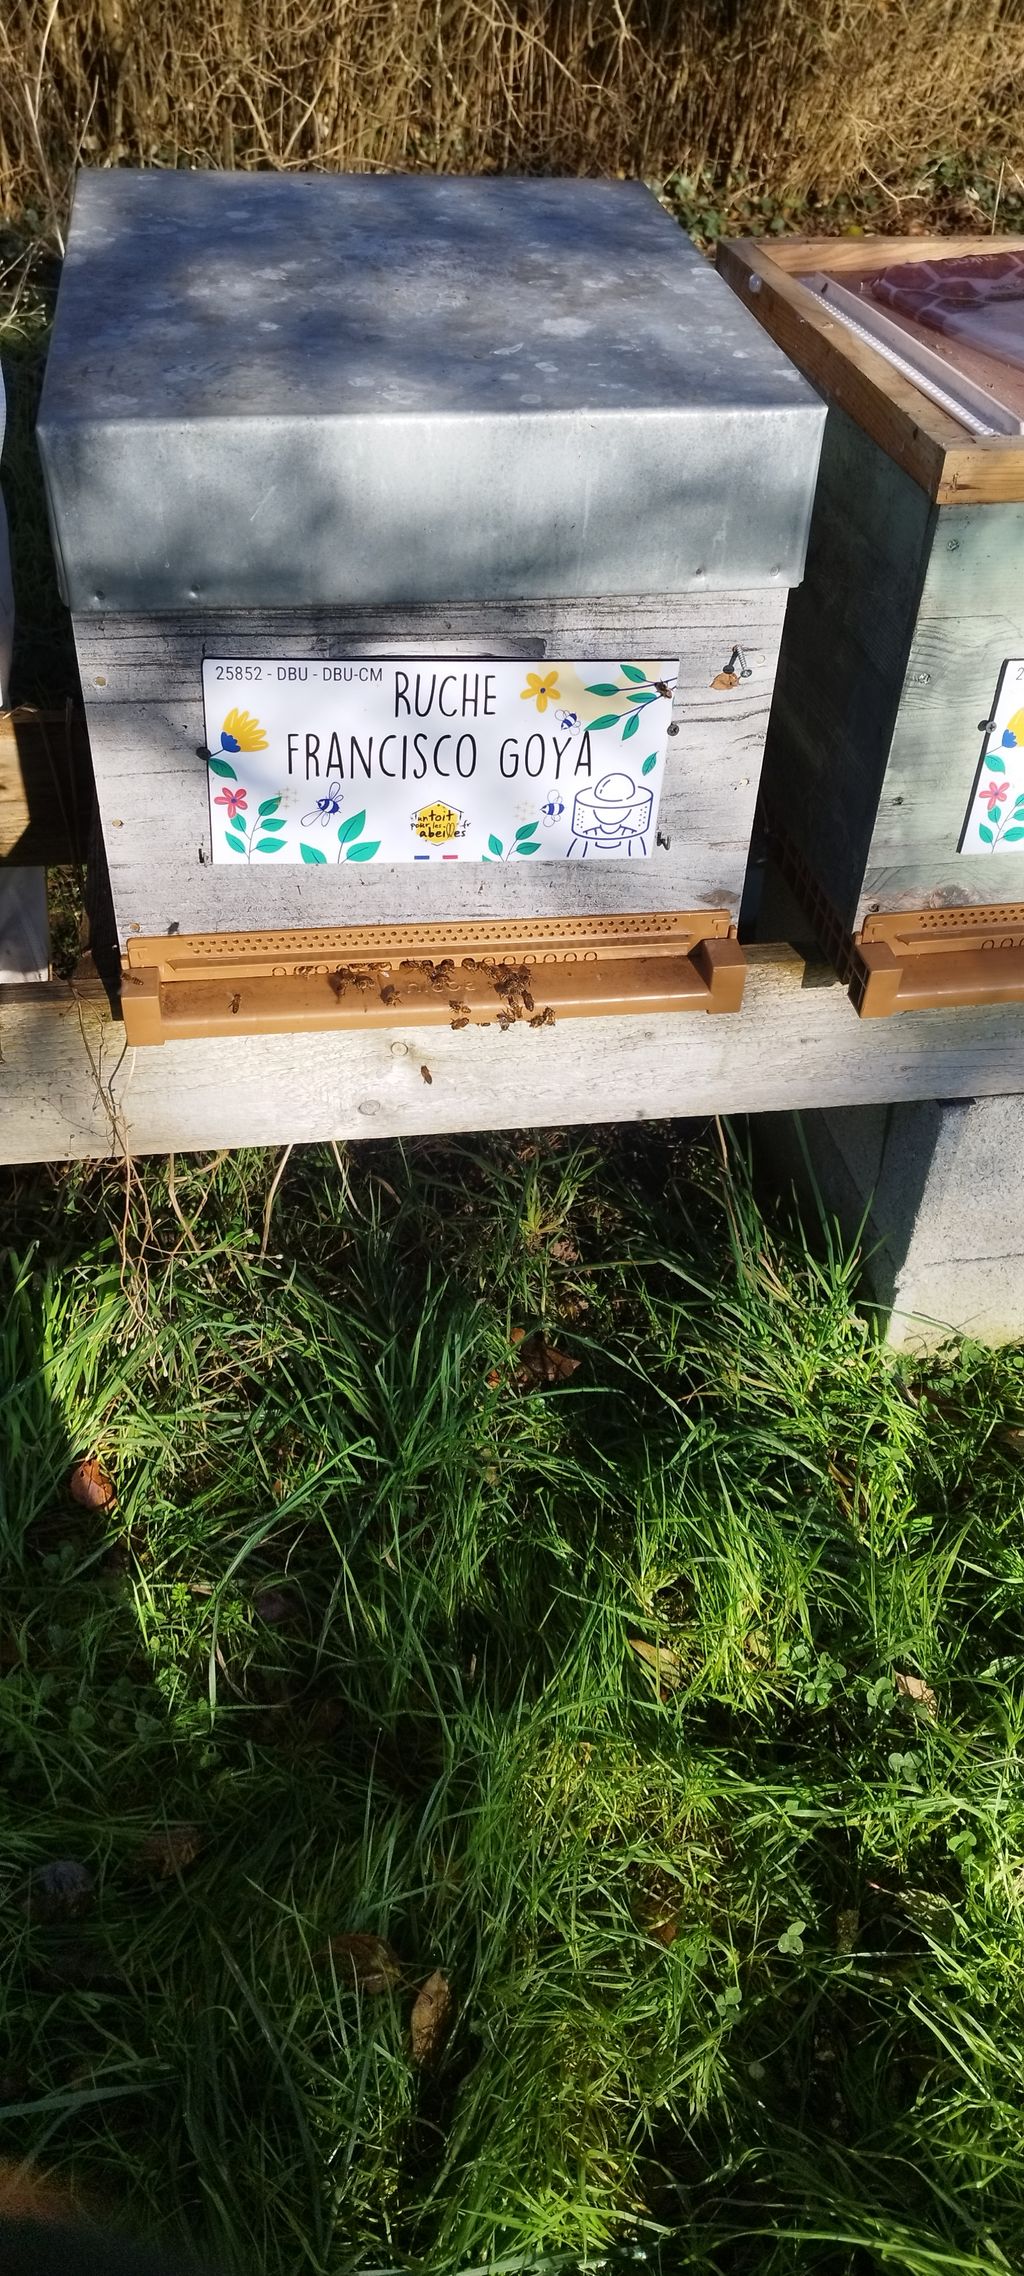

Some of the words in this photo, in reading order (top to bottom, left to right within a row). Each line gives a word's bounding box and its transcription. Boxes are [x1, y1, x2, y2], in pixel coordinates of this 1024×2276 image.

[215, 666, 263, 681] 25852
[276, 667, 308, 681] DBU
[322, 667, 384, 682] DBU-CM
[395, 671, 497, 718] RUCHE
[287, 731, 477, 780] FRANCISCO
[499, 730, 592, 780] GOYA
[419, 823, 466, 838] abeilles
